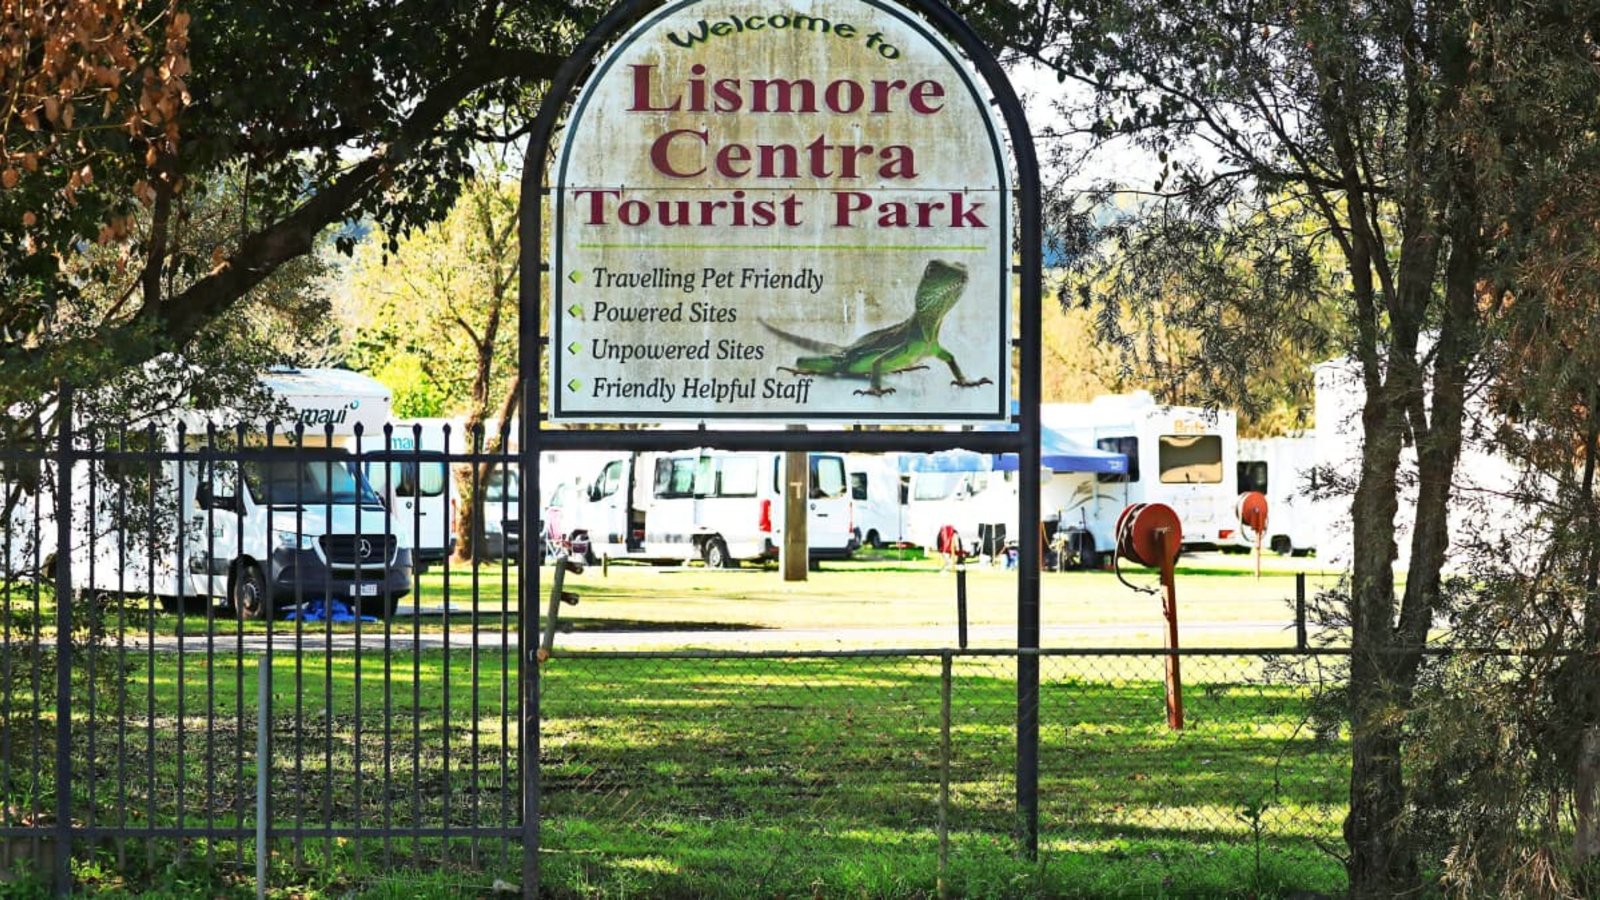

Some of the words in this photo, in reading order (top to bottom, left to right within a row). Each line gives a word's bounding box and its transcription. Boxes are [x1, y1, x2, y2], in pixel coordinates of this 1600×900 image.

[667, 13, 857, 49] Welcome
[866, 31, 900, 60] to
[627, 64, 945, 114] Lismore
[650, 129, 919, 179] Centra
[575, 190, 804, 228] Tourist
[834, 191, 989, 228] Park
[593, 267, 696, 293] Travelling
[702, 268, 734, 288] Pet
[741, 267, 824, 294] Friendly
[592, 301, 683, 323] Powered
[690, 302, 737, 323] Sites
[592, 338, 710, 363] Unpowered
[716, 339, 764, 360] Sites
[592, 377, 676, 403] Friendly
[682, 378, 756, 403] Helpful
[762, 378, 813, 404] Staff
[300, 404, 348, 424] maui
